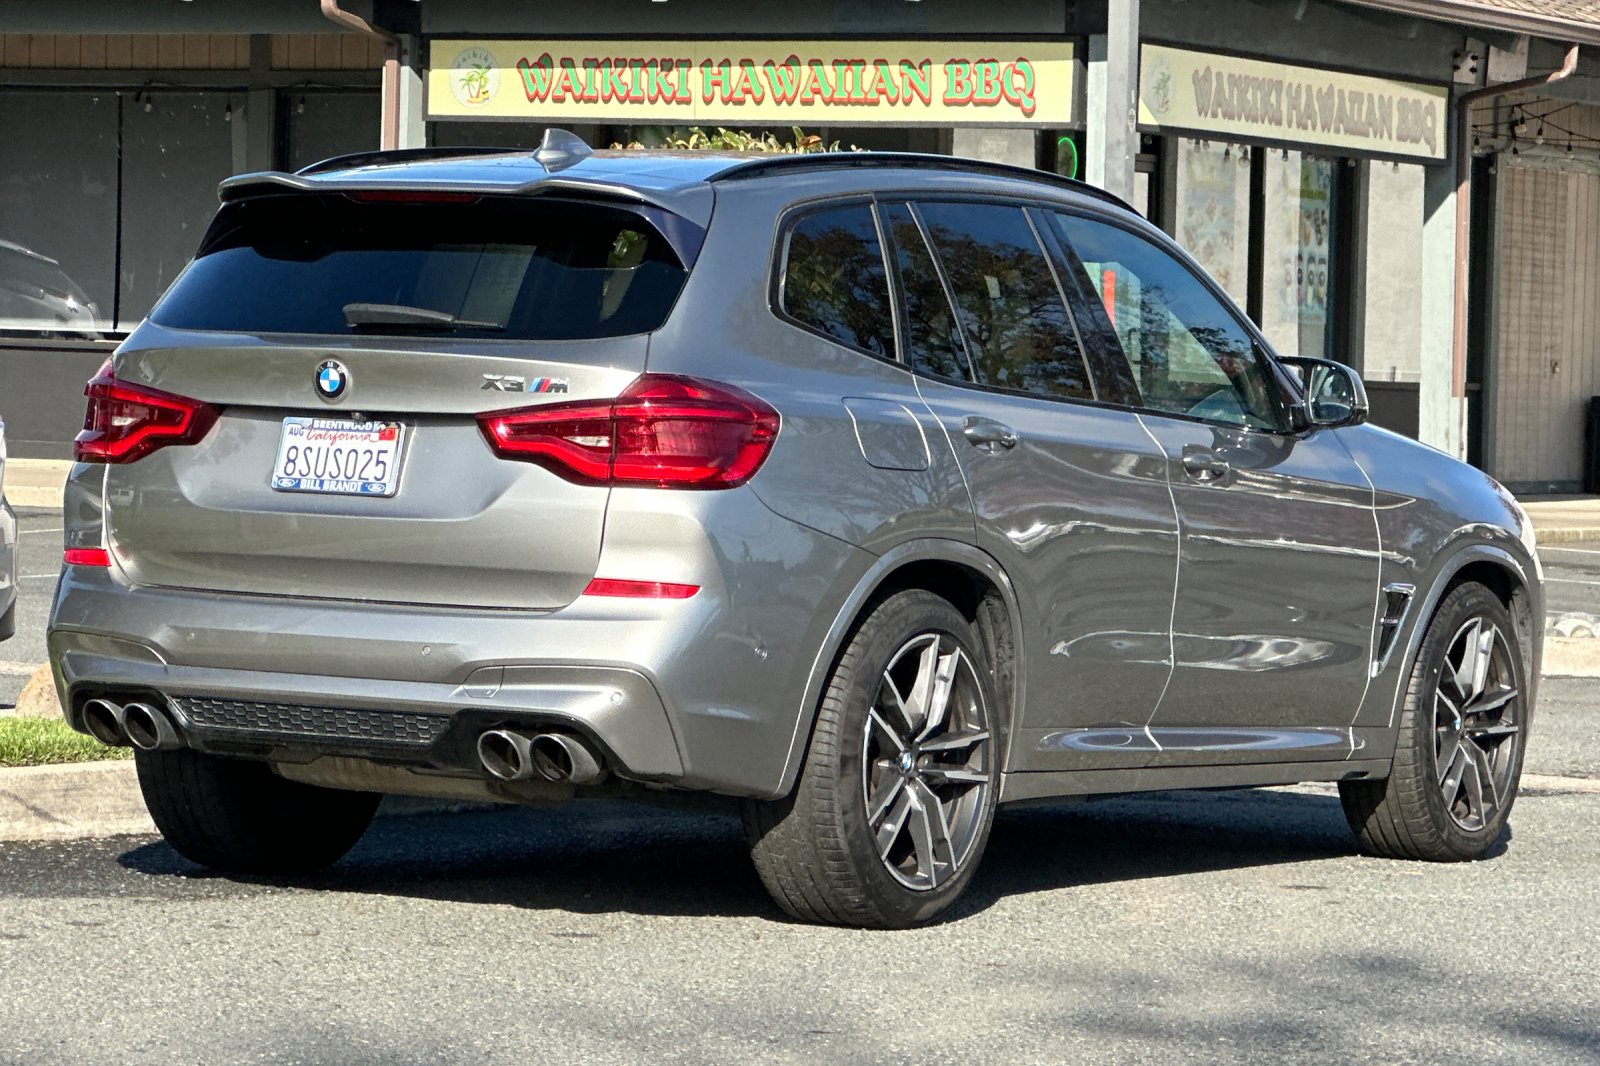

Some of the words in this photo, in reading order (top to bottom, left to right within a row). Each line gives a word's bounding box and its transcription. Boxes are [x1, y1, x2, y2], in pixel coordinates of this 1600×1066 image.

[516, 52, 692, 105] WAIKIKI
[699, 54, 931, 106] HAWAIIAN
[943, 57, 1036, 118] BBQ
[1192, 65, 1283, 127] WAIKIKI
[1285, 82, 1392, 141] HAWAIIAN
[1396, 96, 1437, 156] BBQ
[317, 361, 345, 374] BMW
[480, 373, 526, 393] X3
[288, 426, 304, 437] AUG
[312, 419, 373, 432] BRENTWOOD
[305, 428, 379, 446] California
[283, 445, 389, 482] 8SUS025
[300, 480, 321, 491] BILL
[322, 481, 362, 493] BRANDT
